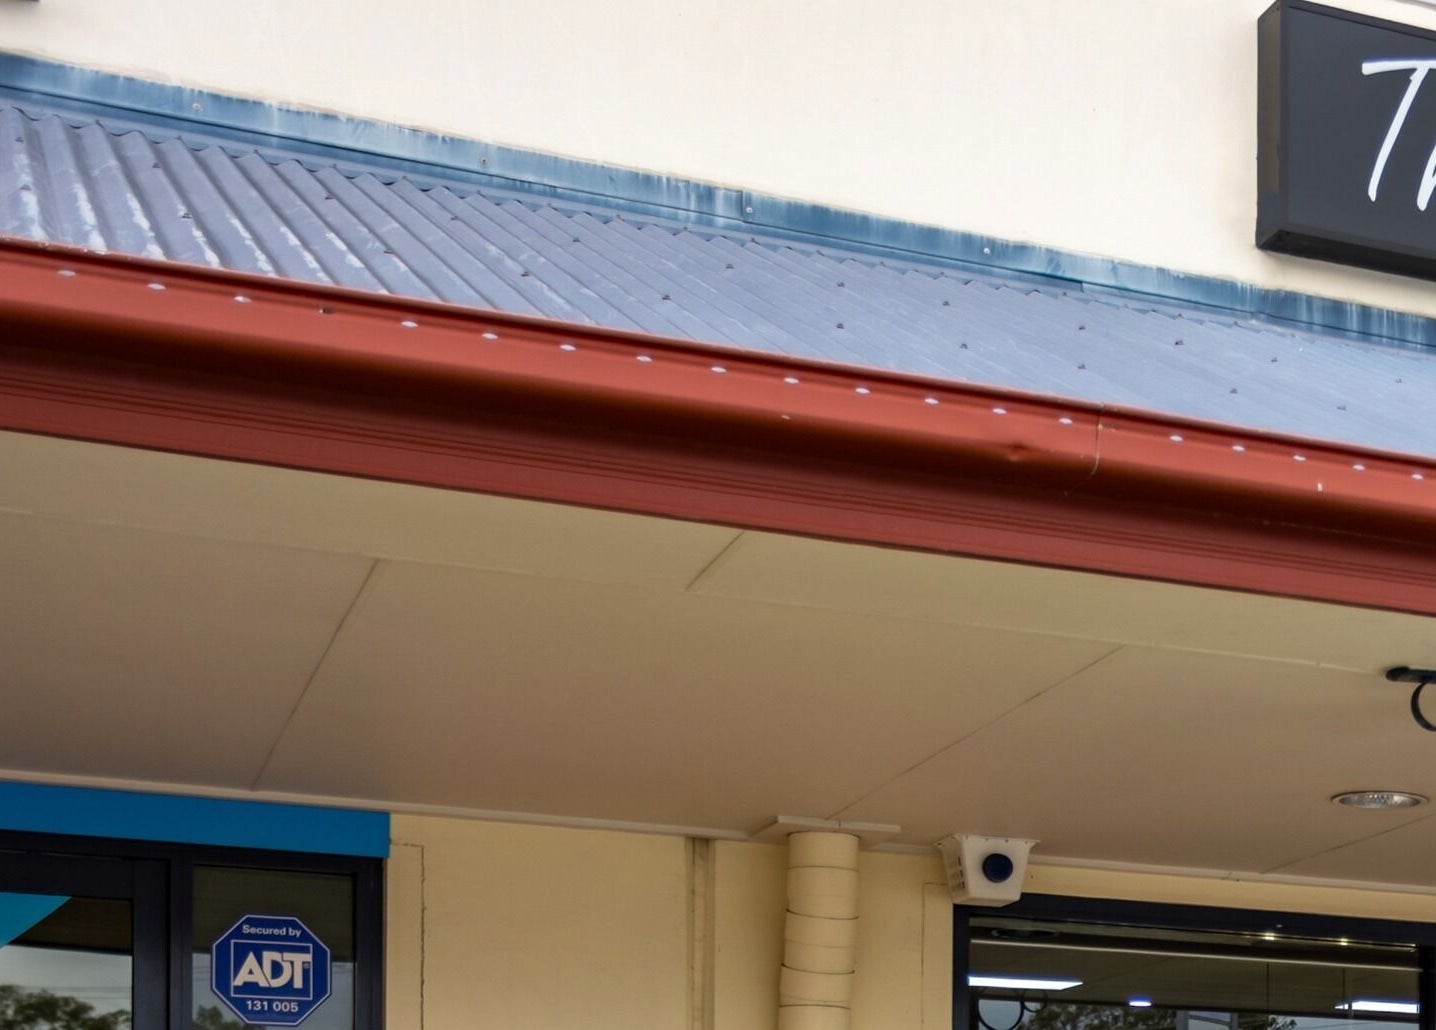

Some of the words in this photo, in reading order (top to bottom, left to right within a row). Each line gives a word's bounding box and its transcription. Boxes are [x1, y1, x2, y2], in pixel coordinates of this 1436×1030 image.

[242, 924, 287, 936] Secured
[288, 927, 302, 938] by
[232, 951, 312, 989] ADT
[246, 1000, 268, 1012] 131
[272, 1001, 299, 1013] 005
